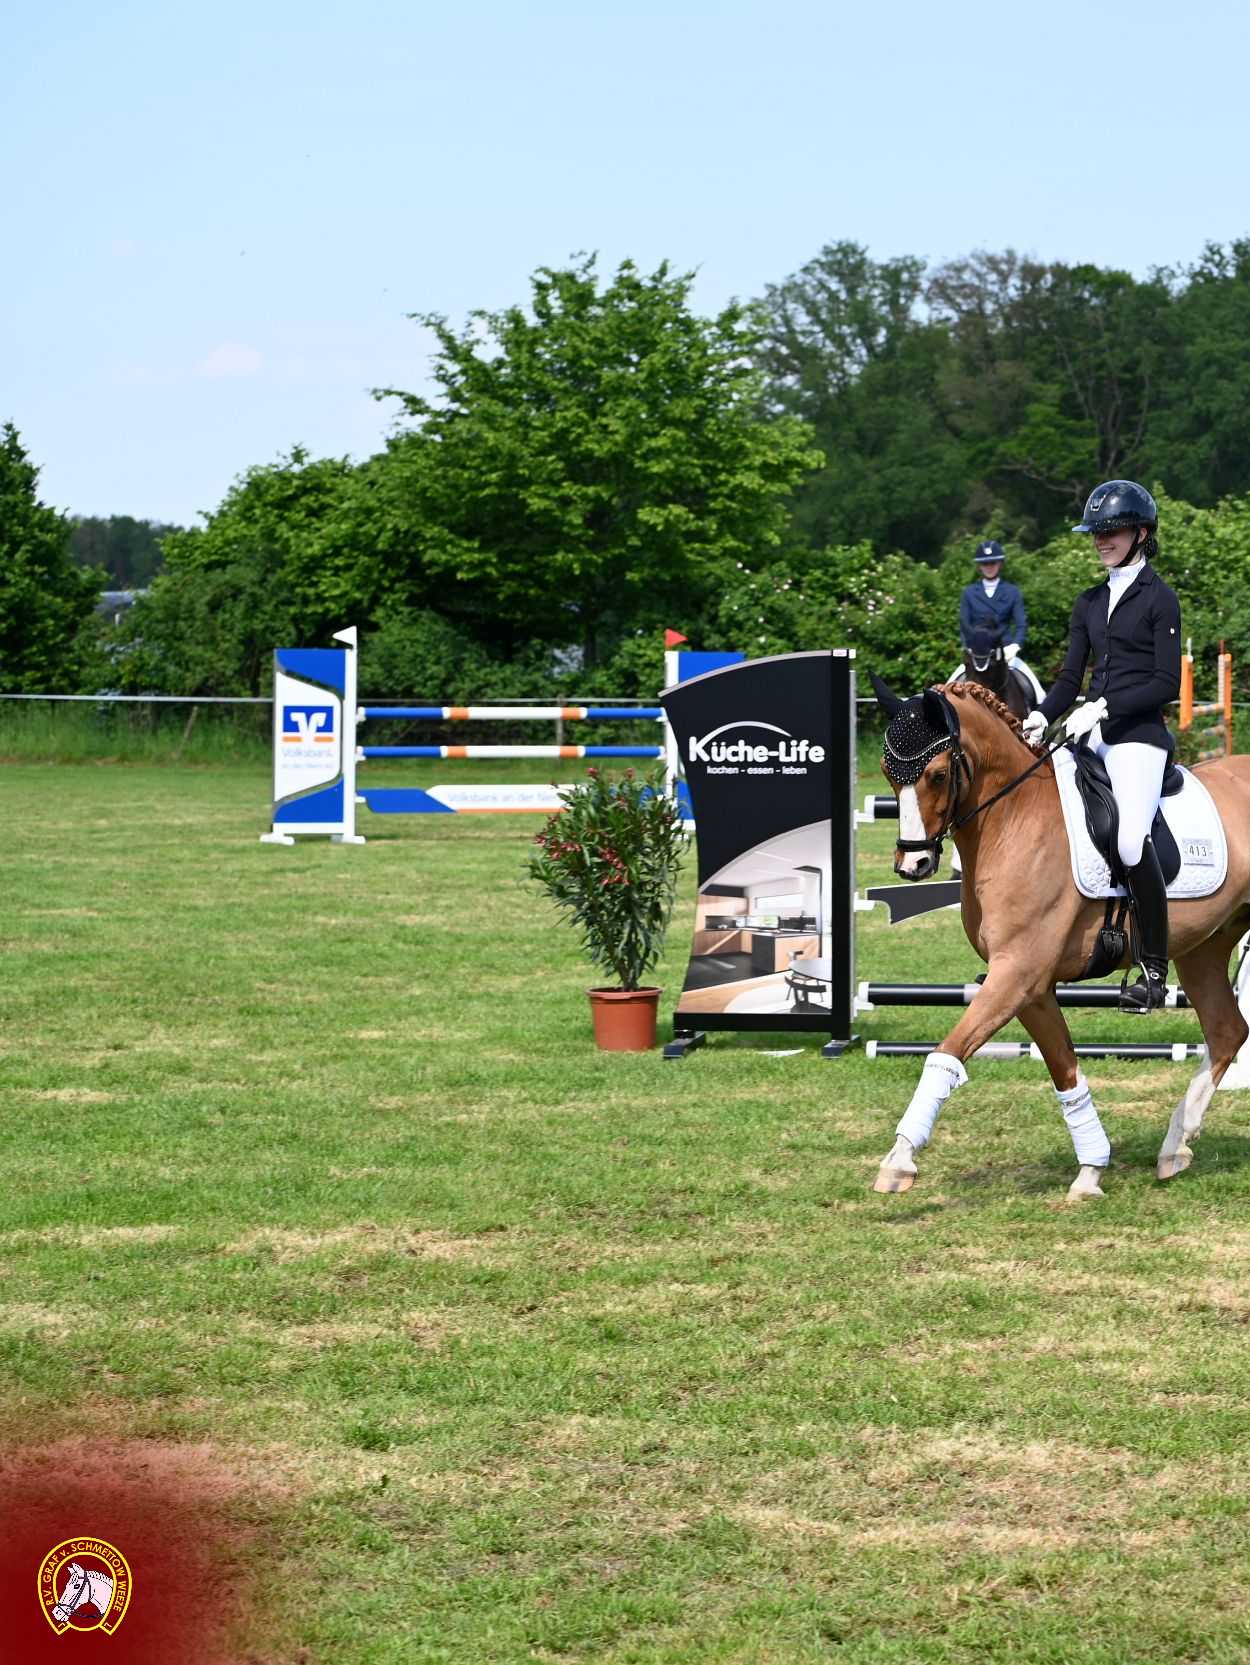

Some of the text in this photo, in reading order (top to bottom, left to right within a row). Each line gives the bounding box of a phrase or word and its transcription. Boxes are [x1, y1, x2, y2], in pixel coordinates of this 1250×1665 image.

[688, 736, 825, 763] Küche-Life
[706, 765, 739, 775] kochen
[747, 766, 774, 775] essen
[782, 765, 808, 775] leben
